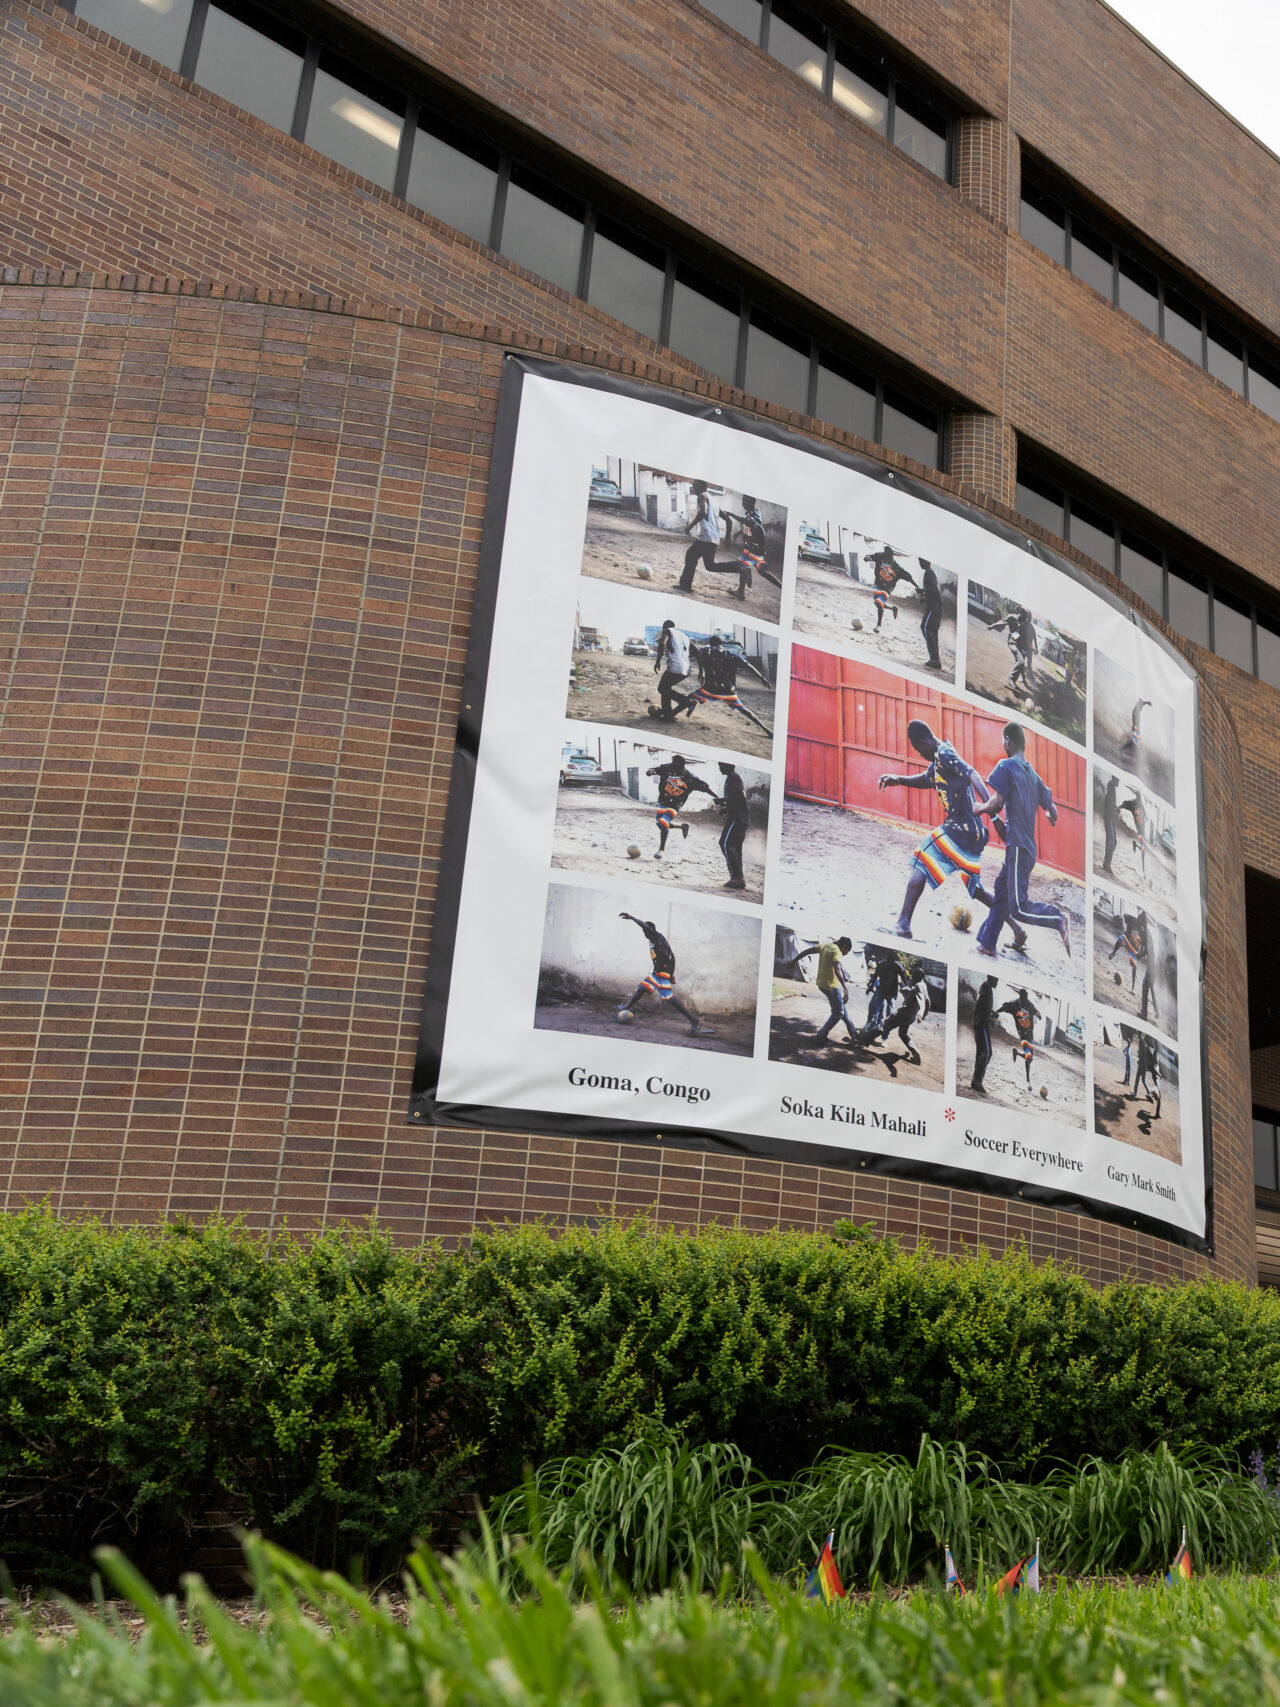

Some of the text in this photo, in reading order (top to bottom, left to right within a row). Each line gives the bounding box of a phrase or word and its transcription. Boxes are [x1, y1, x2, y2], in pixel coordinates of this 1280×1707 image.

[568, 1067, 710, 1103] Goma, Congo
[780, 1095, 926, 1136] Soka Kila Mahali
[964, 1129, 1083, 1172] Soccer Everywhere
[1107, 1165, 1176, 1201] Gary Mark Smith
